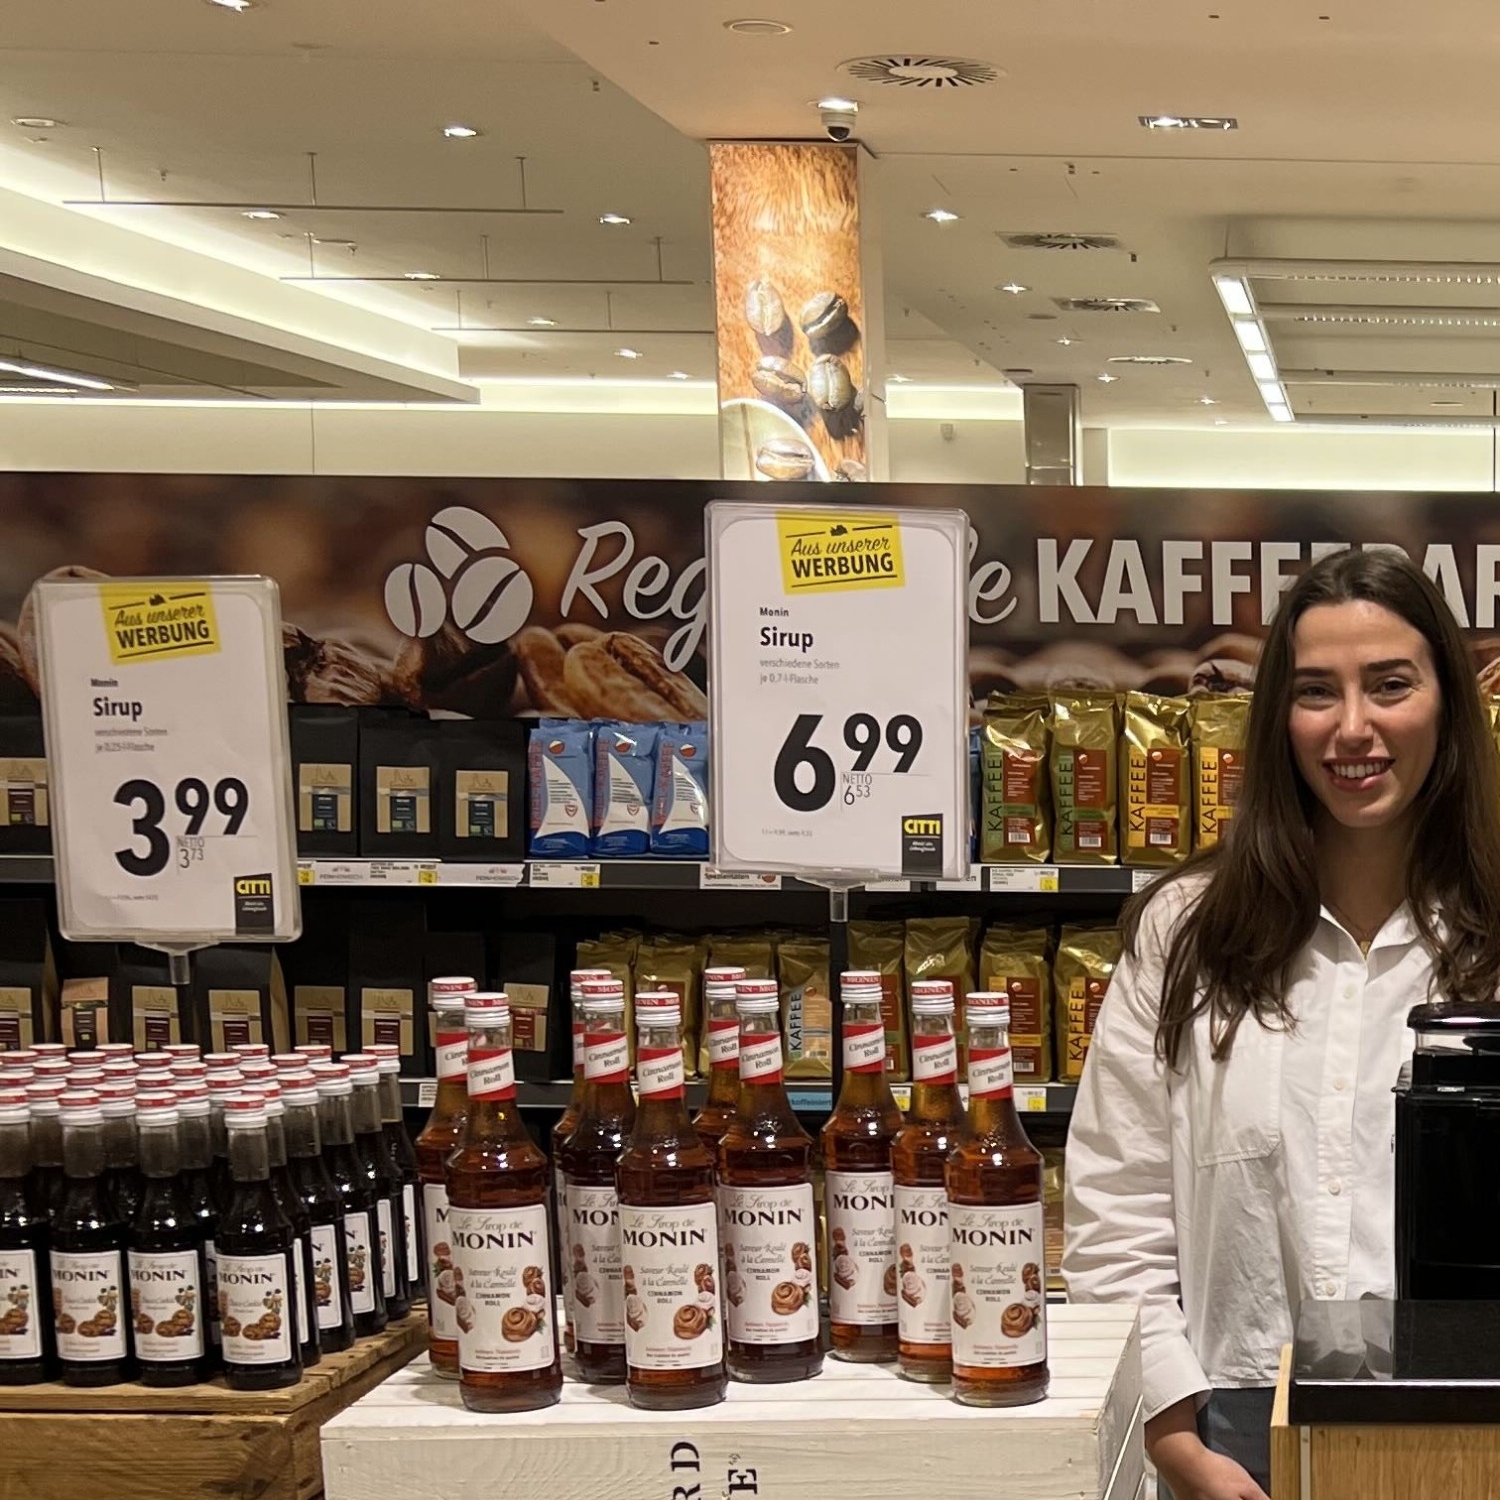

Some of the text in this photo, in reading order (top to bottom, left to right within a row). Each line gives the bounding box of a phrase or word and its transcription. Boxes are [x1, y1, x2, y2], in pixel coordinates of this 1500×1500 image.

[791, 532, 891, 557] Aus unserer
[791, 552, 894, 578] WERBUNG
[114, 602, 206, 629] Aus unserer
[760, 607, 789, 617] Monin
[116, 618, 210, 649] WERBUNG
[760, 627, 813, 653] Sirup
[760, 658, 840, 671] verschiedene Sorten
[93, 697, 142, 722] Sirup
[842, 773, 873, 785] NETTO
[1059, 761, 1074, 836] KAFFEE
[1130, 757, 1146, 832] KAFFEE
[1201, 760, 1217, 834] KAFFEE
[904, 818, 940, 836] CITTI
[863, 1046, 880, 1057] Roll
[469, 1060, 510, 1079] Cinnamon
[603, 1056, 621, 1068] Roll
[641, 1060, 682, 1078] Cinnamon
[755, 1056, 772, 1068] Roll
[934, 1058, 950, 1068] Roll
[483, 1073, 502, 1085] Roll
[657, 1072, 674, 1084] Roll
[987, 1073, 1005, 1084] Roll
[841, 1179, 854, 1193] Le
[730, 1194, 792, 1212] Le Sirop de
[833, 1194, 894, 1211] MONI
[457, 1215, 475, 1229] Le
[476, 1214, 508, 1233] Sirop
[509, 1220, 525, 1229] de
[629, 1214, 695, 1232] Le Sirop de
[724, 1208, 802, 1227] MONIN
[959, 1213, 1025, 1233] Le Sirop de
[452, 1230, 534, 1250] MONIN
[623, 1229, 706, 1248] MONIN
[952, 1227, 1033, 1246] MONIN
[485, 1299, 501, 1307] ROLL
